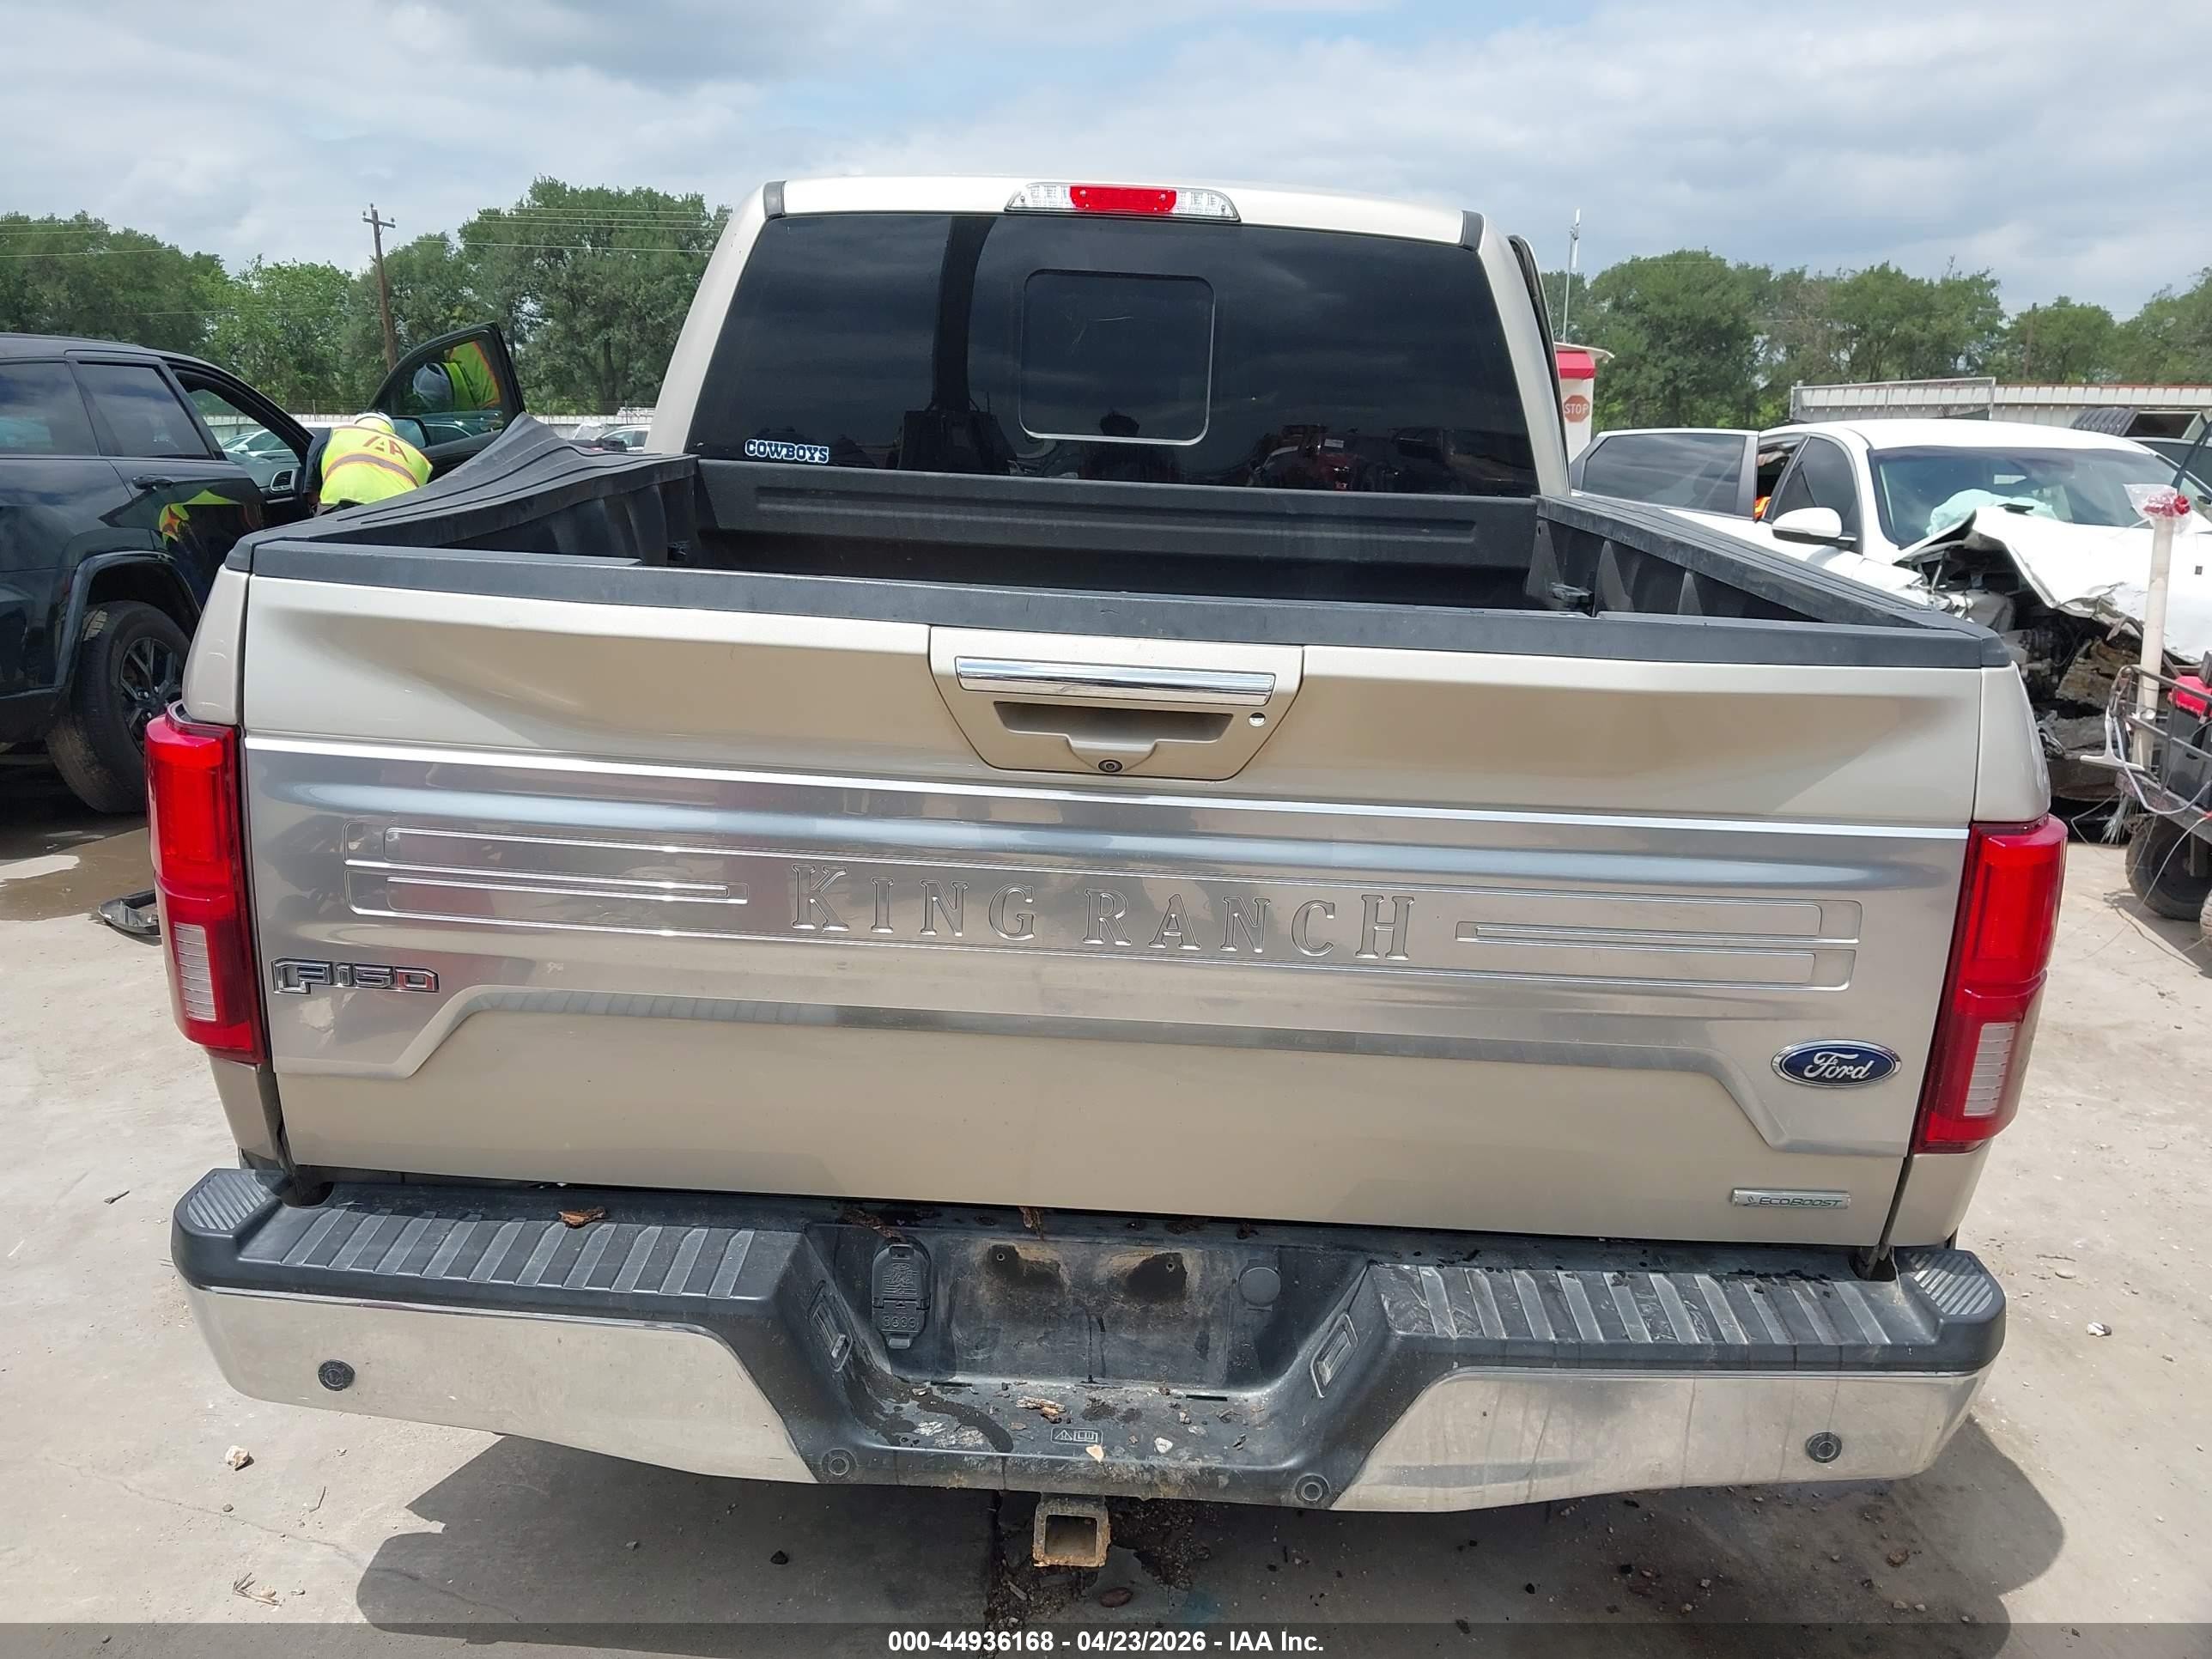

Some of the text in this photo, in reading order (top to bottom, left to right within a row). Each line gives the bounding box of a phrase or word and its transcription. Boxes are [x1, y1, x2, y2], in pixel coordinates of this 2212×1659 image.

[1565, 403, 1589, 415] STOP
[744, 439, 830, 464] COWBOYS
[789, 862, 1417, 962] KING RANCH
[270, 957, 441, 995] F150
[1803, 1050, 1875, 1079] Ford
